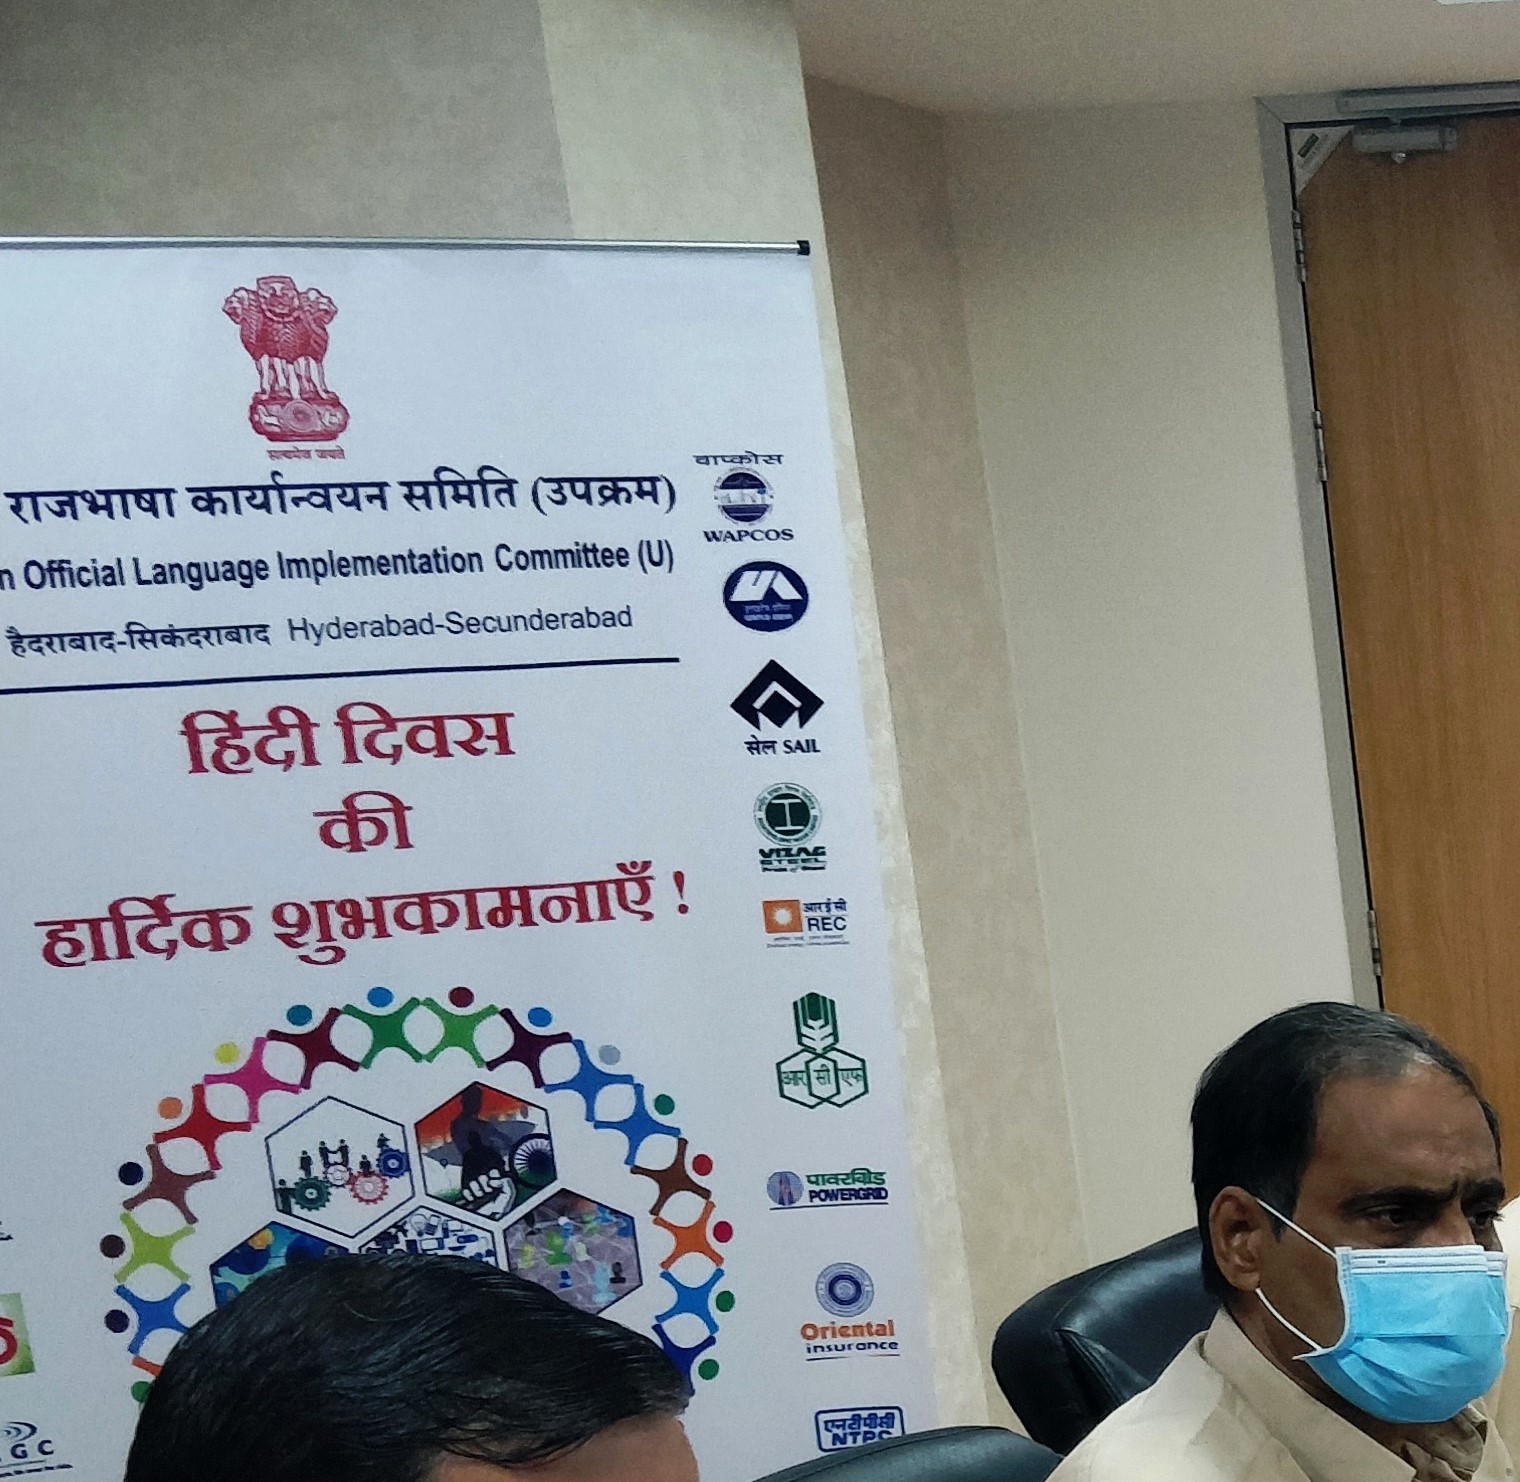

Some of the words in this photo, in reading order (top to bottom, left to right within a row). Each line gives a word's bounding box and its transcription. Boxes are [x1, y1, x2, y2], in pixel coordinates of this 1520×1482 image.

[4, 487, 178, 524] राजभाषा
[185, 470, 391, 515] कार्यान्वयन
[397, 465, 519, 511] समिति
[531, 474, 676, 516] (उपक्रम)
[702, 529, 795, 543] WAPCOS
[24, 557, 126, 590] Official
[132, 555, 270, 591] Language
[276, 546, 484, 585] Implementation
[495, 541, 630, 572] Committee
[638, 539, 674, 574] (U)
[287, 605, 633, 646] Hyderabad-Secunderabad
[179, 705, 321, 774] हिंदी
[334, 701, 517, 765] दिवस
[744, 735, 778, 756] सेल
[783, 738, 821, 754] SAIL
[312, 790, 415, 853] की
[759, 846, 826, 859] VIZAG
[35, 893, 253, 968] हार्दिक
[271, 860, 656, 966] शुभकामनाएँ
[807, 916, 847, 932] REC
[808, 1188, 889, 1203] POWERGRID
[800, 1320, 895, 1341] Oriental
[806, 1341, 899, 1355] insurance
